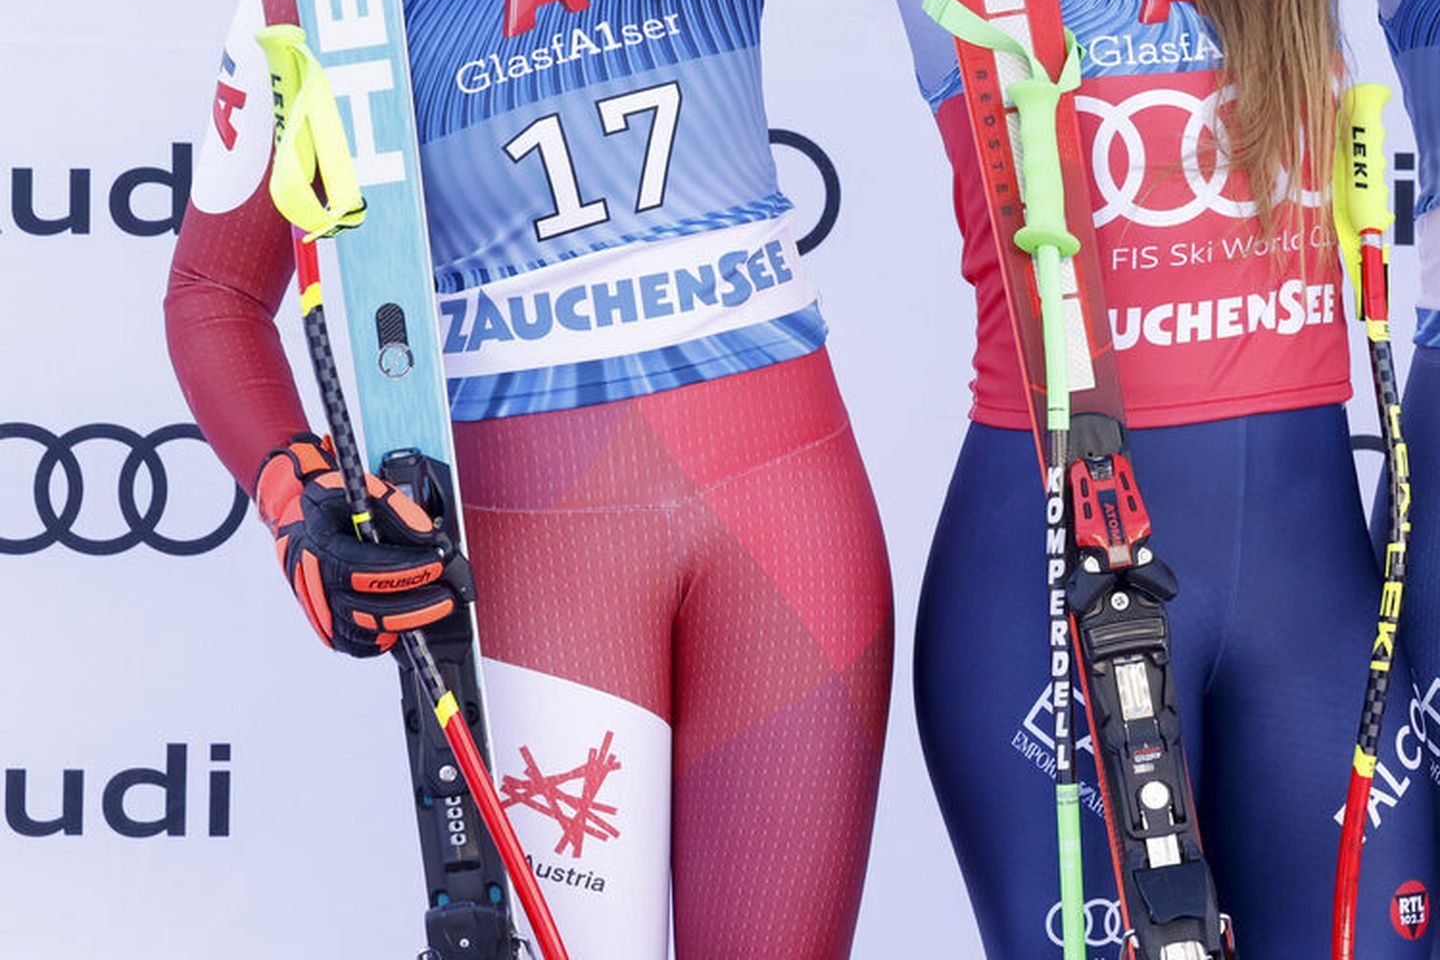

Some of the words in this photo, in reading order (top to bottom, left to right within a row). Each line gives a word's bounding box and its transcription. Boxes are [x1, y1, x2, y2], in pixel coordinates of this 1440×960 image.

[455, 12, 680, 93] GlasfA1ser
[1089, 36, 1225, 67] GlasfA
[0, 141, 193, 237] ud
[502, 80, 682, 242] 17
[1351, 126, 1369, 190] LEKI
[1111, 245, 1159, 272] FIS
[1170, 240, 1213, 267] Ski
[440, 239, 794, 355] ZAUCHENSEE
[1108, 278, 1334, 351] UCHENSEE
[369, 569, 433, 590] reusch
[1046, 466, 1070, 771] KOMPERDELL
[1369, 542, 1407, 671] LEKI
[4, 743, 231, 838] udi
[1398, 895, 1425, 913] RTL
